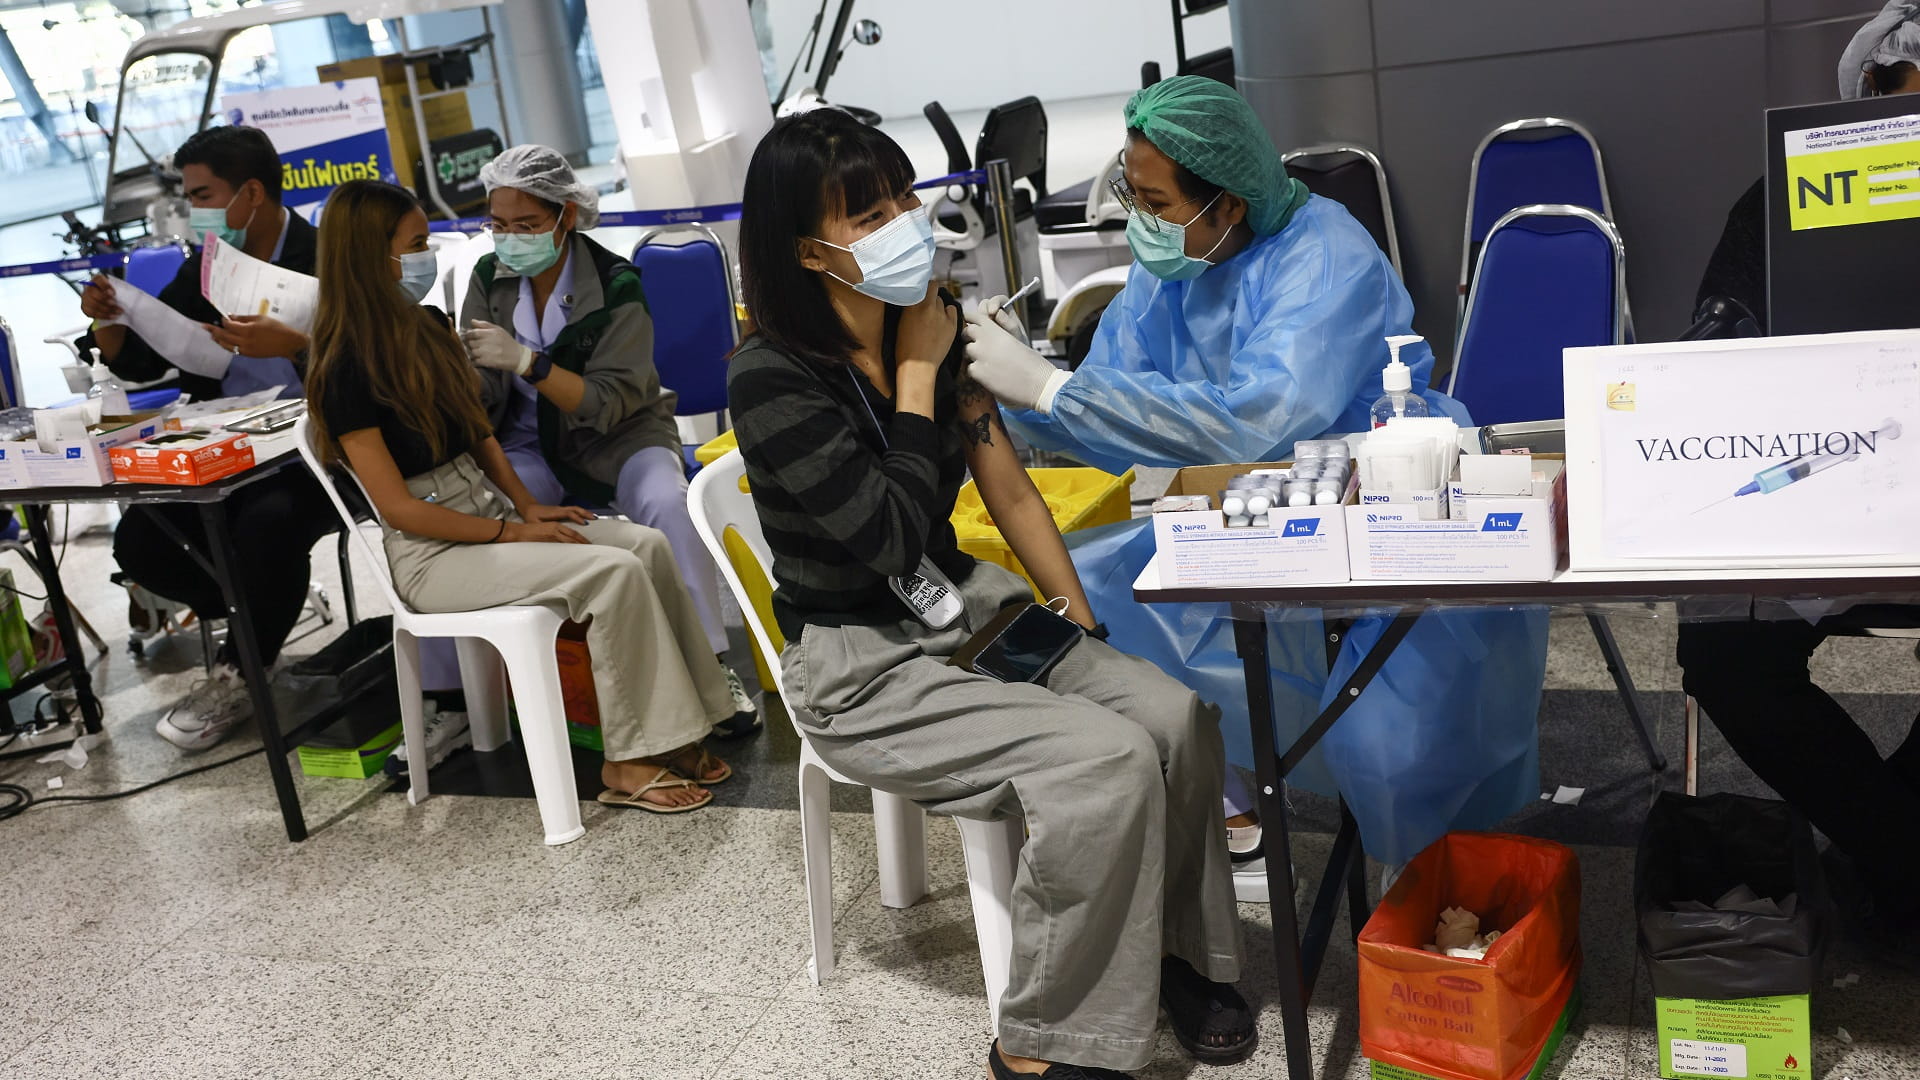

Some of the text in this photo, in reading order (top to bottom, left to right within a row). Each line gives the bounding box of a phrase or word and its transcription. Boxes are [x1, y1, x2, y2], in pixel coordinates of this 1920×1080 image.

[1806, 140, 1832, 150] National
[1867, 162, 1904, 172] Computer
[1798, 170, 1858, 209] NT
[1869, 186, 1892, 194] Printer
[1635, 430, 1880, 462] VACCINATION
[1364, 495, 1390, 503] NIPRO
[1391, 982, 1473, 1016] Alcohol
[1386, 1007, 1474, 1034] Cotton Ball
